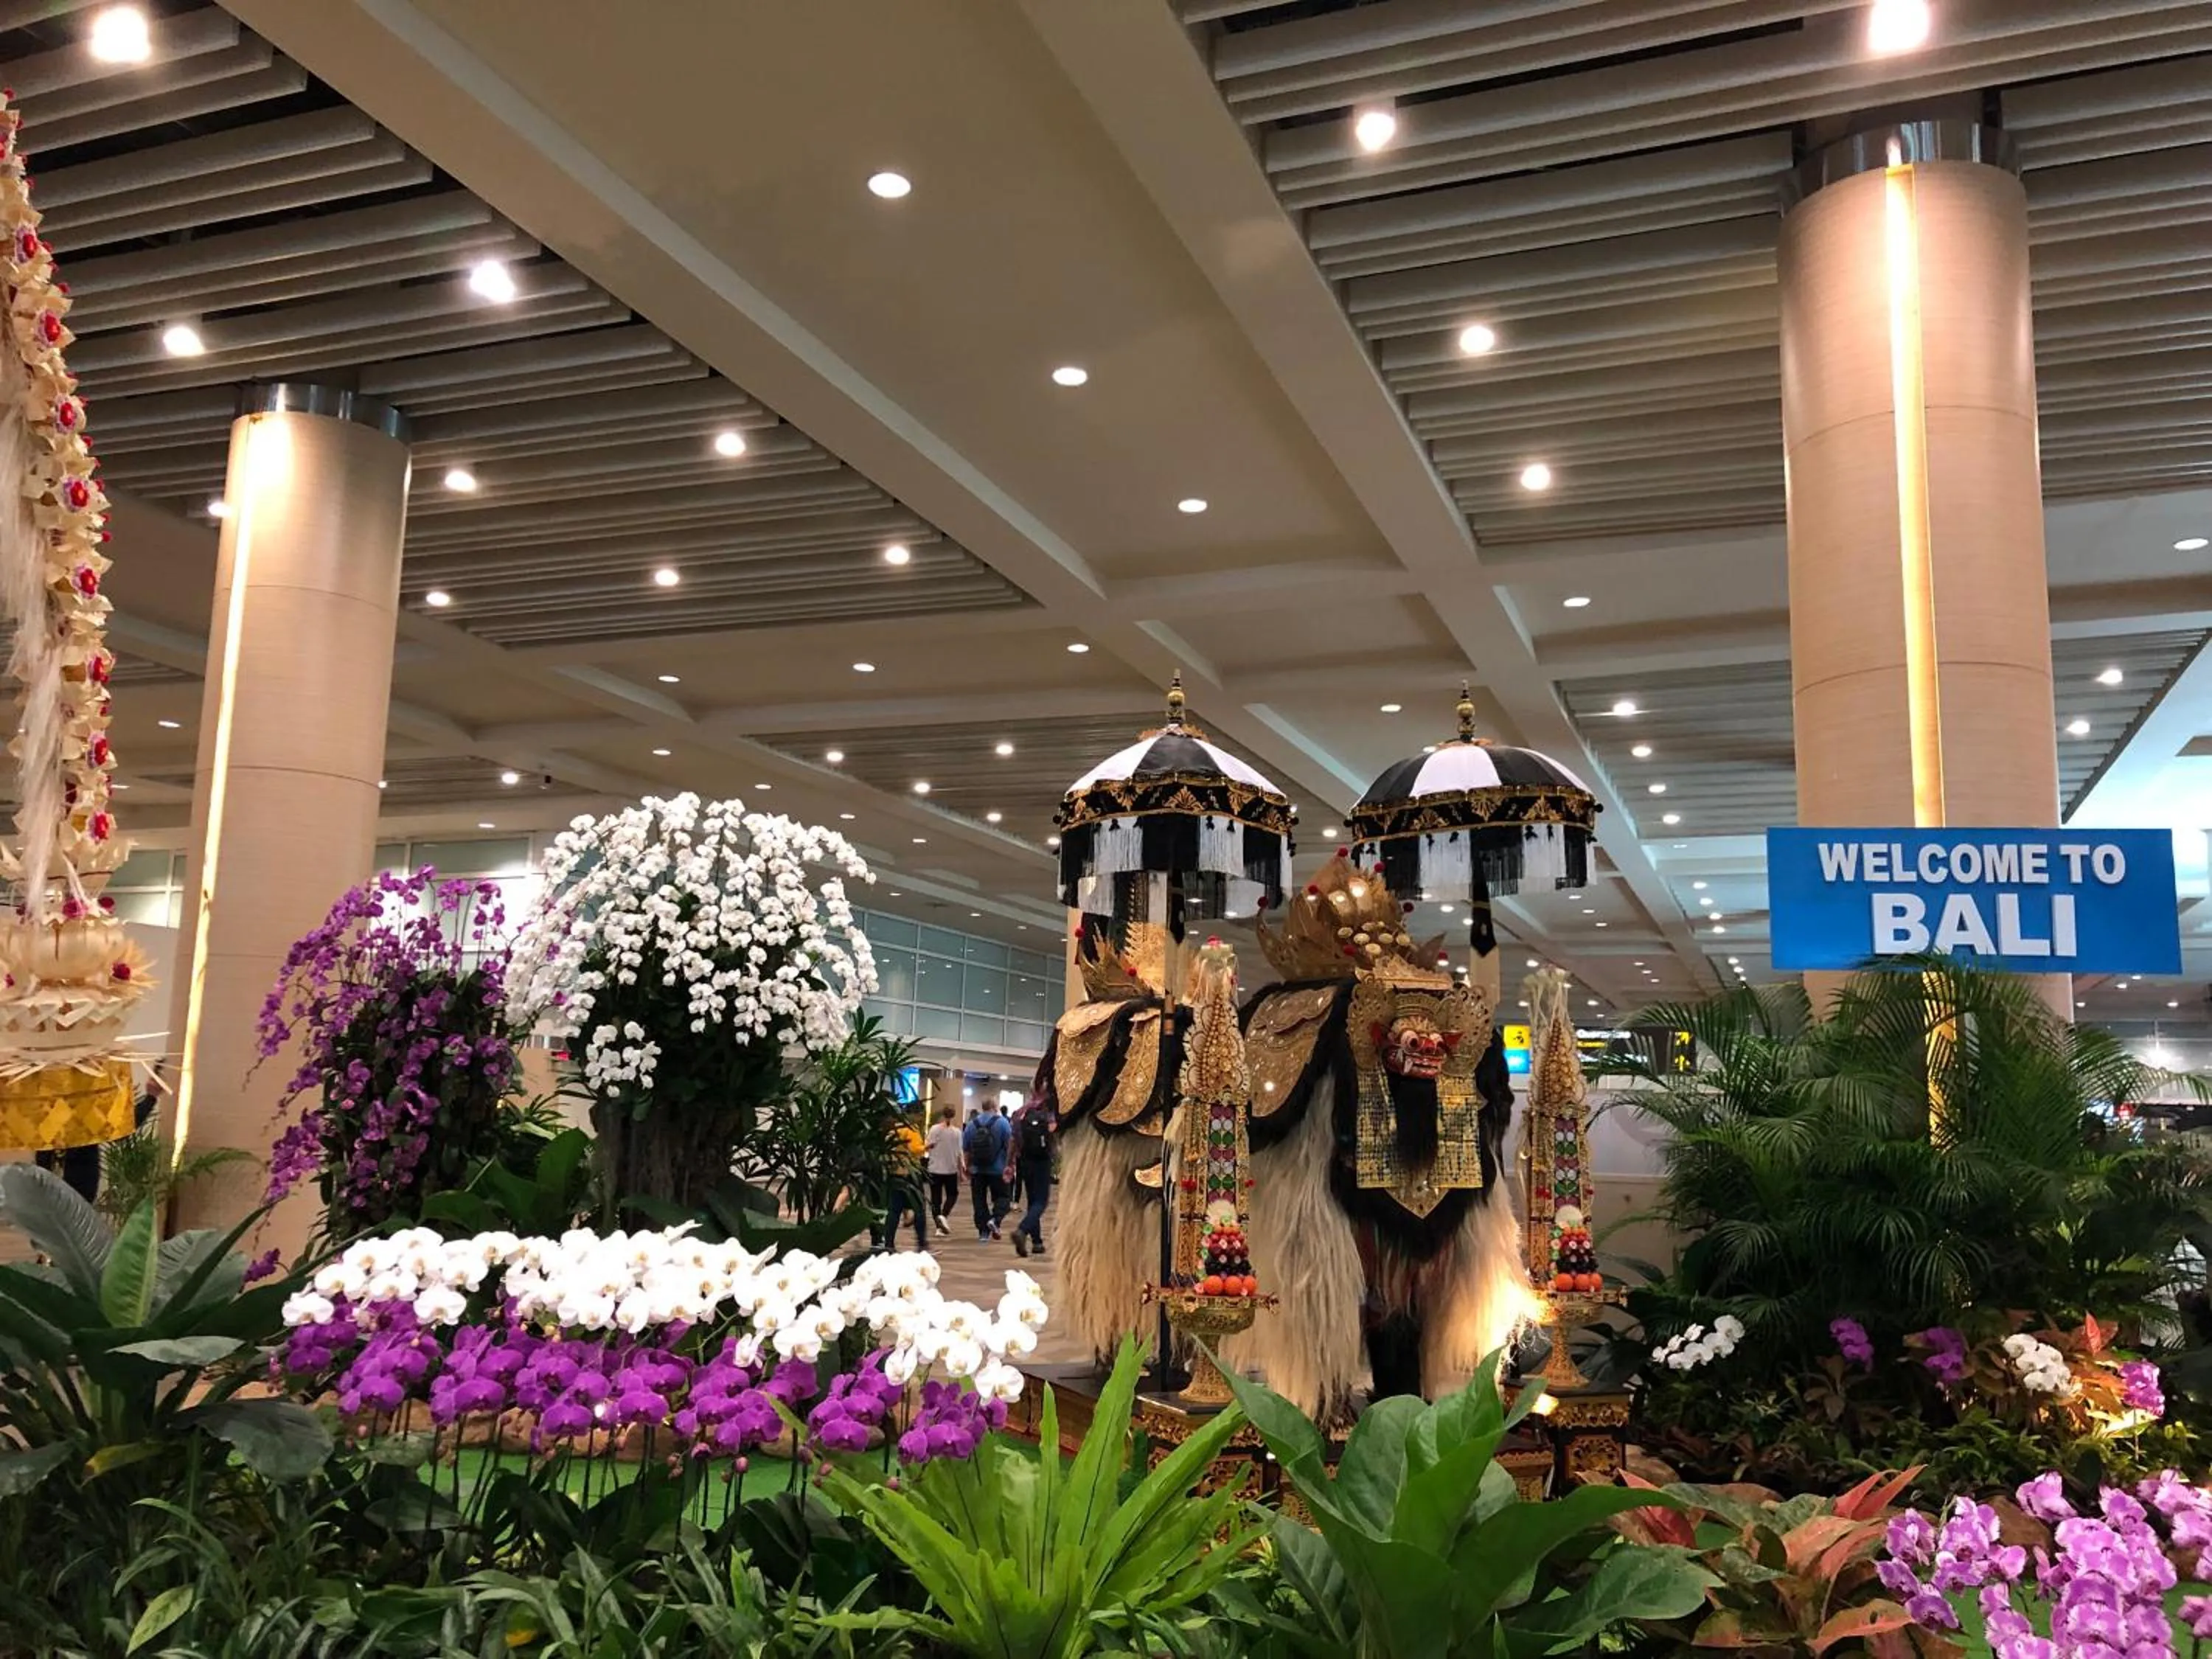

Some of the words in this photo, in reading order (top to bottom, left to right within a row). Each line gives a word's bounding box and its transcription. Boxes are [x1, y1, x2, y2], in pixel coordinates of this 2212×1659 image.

[1818, 843, 2049, 883] WELCOME
[2059, 844, 2126, 884] TO
[1871, 893, 2077, 956] BALI
